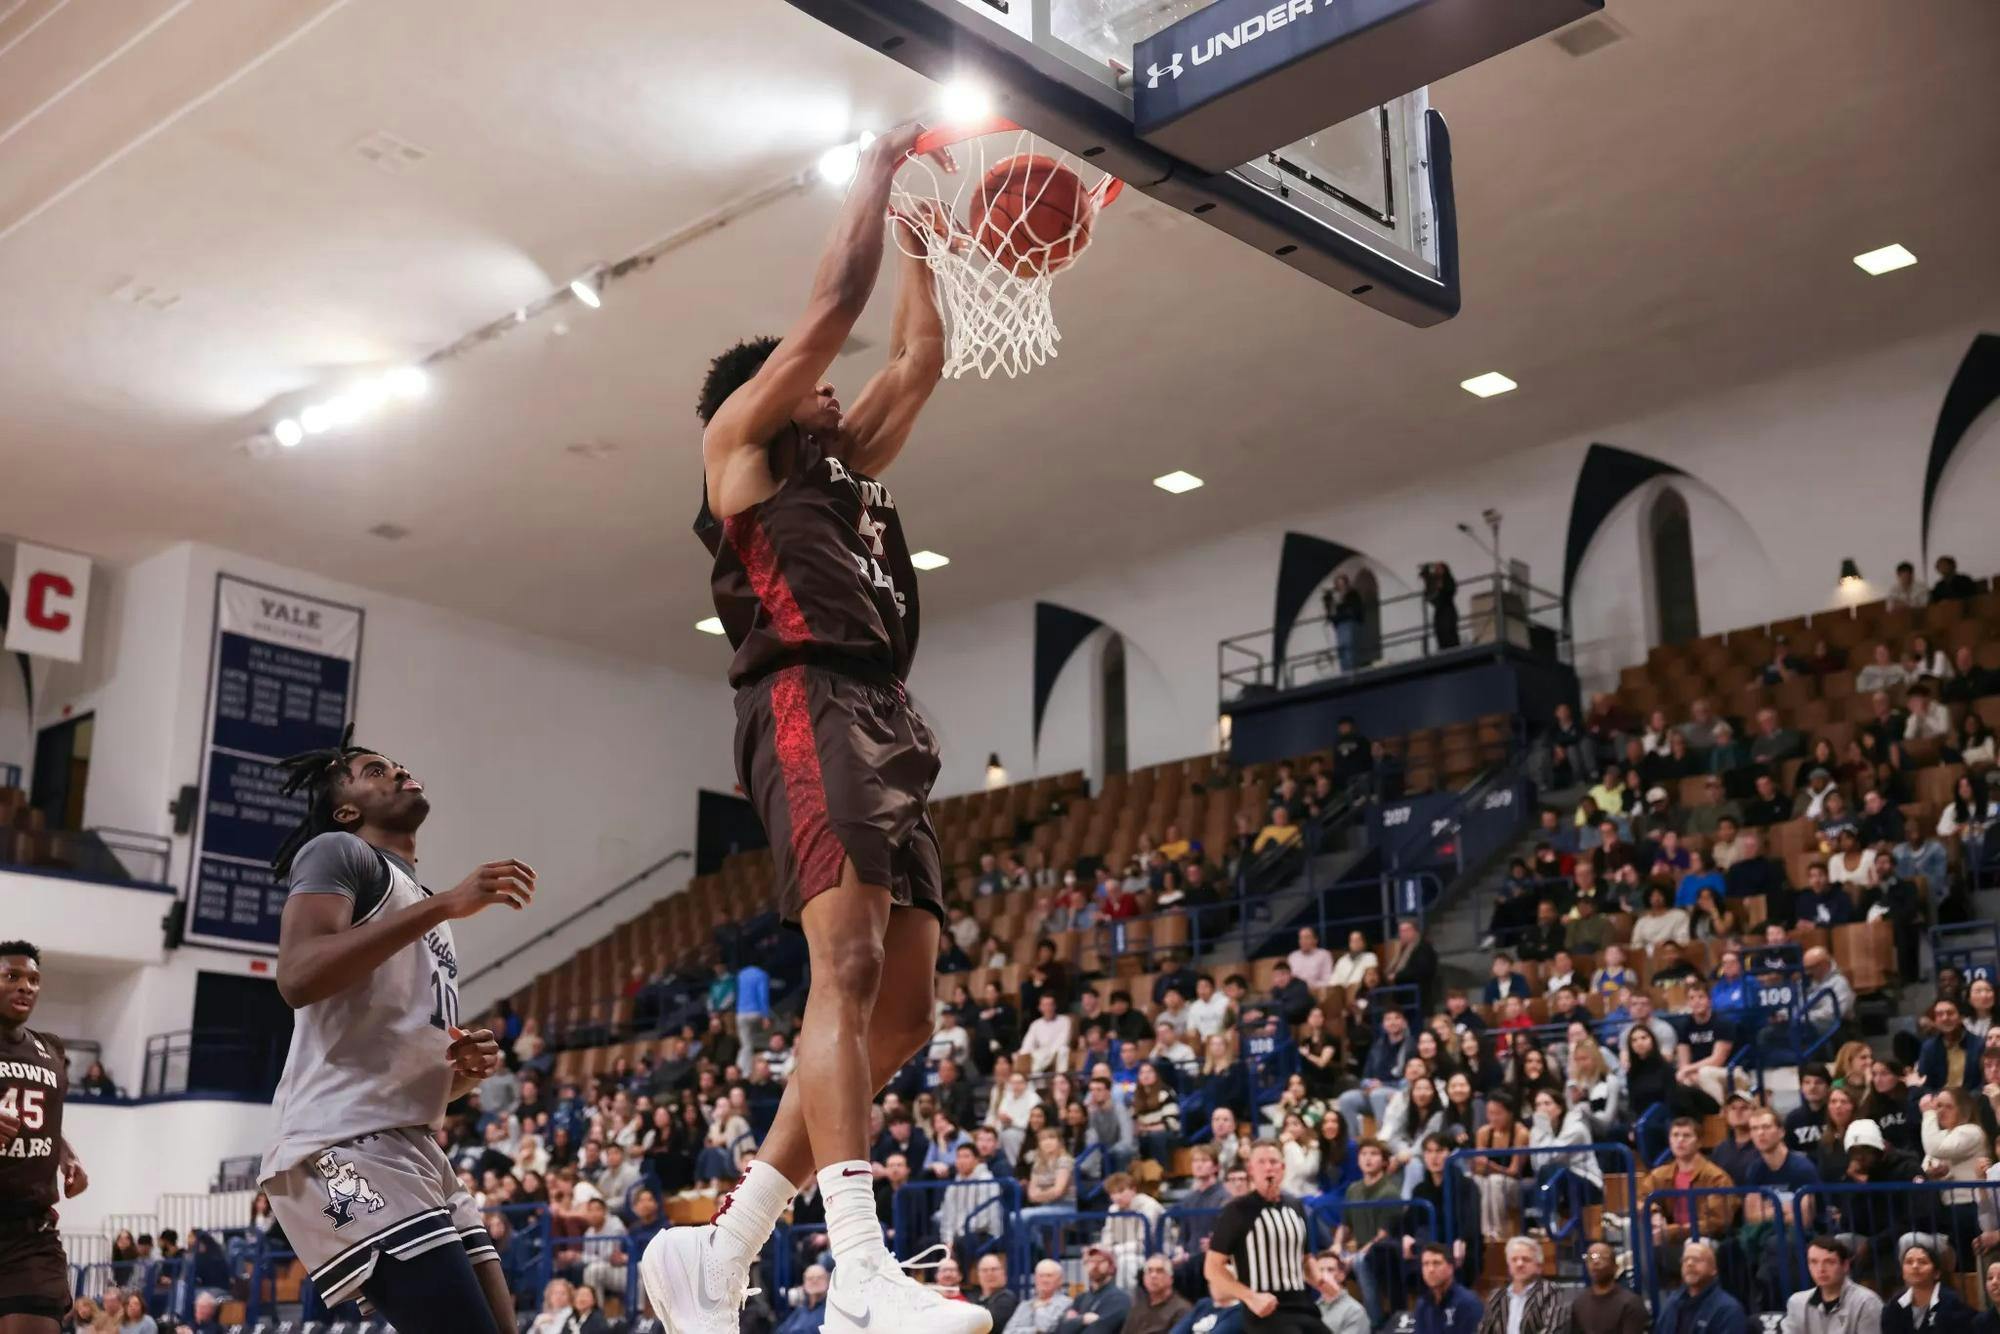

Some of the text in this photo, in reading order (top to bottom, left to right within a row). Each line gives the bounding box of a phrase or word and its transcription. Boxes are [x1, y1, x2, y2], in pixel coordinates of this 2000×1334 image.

[1191, 0, 1314, 66] UNDER
[25, 571, 74, 634] C
[260, 598, 322, 630] YALE
[1758, 987, 1792, 1006] 109
[0, 1087, 44, 1130] 45
[0, 1137, 53, 1158] ARS
